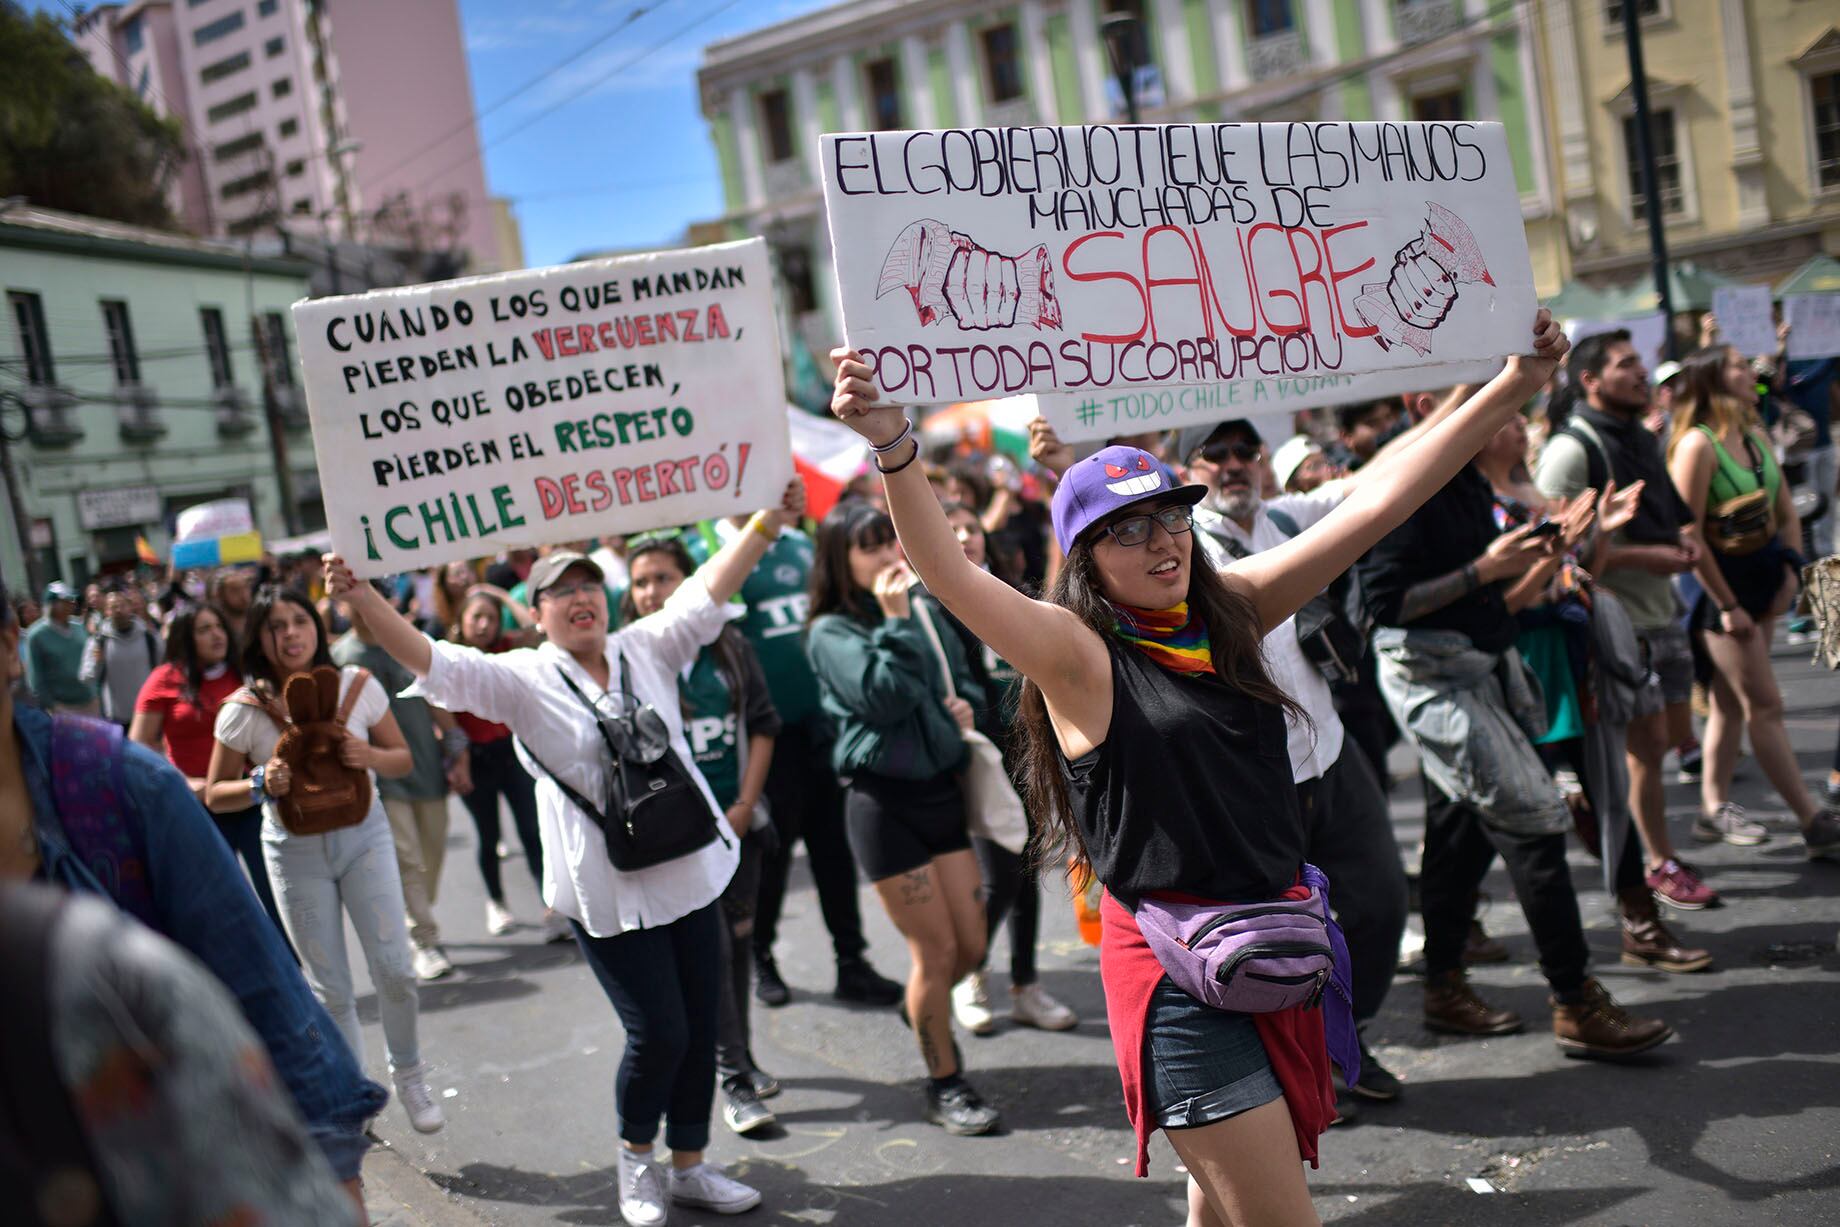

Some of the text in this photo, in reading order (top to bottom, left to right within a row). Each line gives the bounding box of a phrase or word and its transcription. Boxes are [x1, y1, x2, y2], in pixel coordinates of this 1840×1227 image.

[835, 122, 1487, 197] EL GOBIERNO TIENE LAS MANOS
[1029, 185, 1335, 231] MANCHADAS DE
[325, 265, 746, 353] CUANDO LOS QUE MANDAN
[1062, 219, 1380, 345] SANGRE
[342, 344, 479, 394] PIERDEN
[486, 336, 529, 367] LA
[360, 361, 681, 440] LOS QUE OBEDECEN,
[936, 340, 1057, 397] TODA
[1060, 339, 1116, 387] SU
[1074, 391, 1175, 427] #TODO
[1179, 383, 1243, 412] CHILE
[1253, 378, 1269, 401] A
[372, 407, 694, 488] PIERDEN EL RESPETO
[360, 443, 751, 561] ¡CHILE DESPERTÓ!
